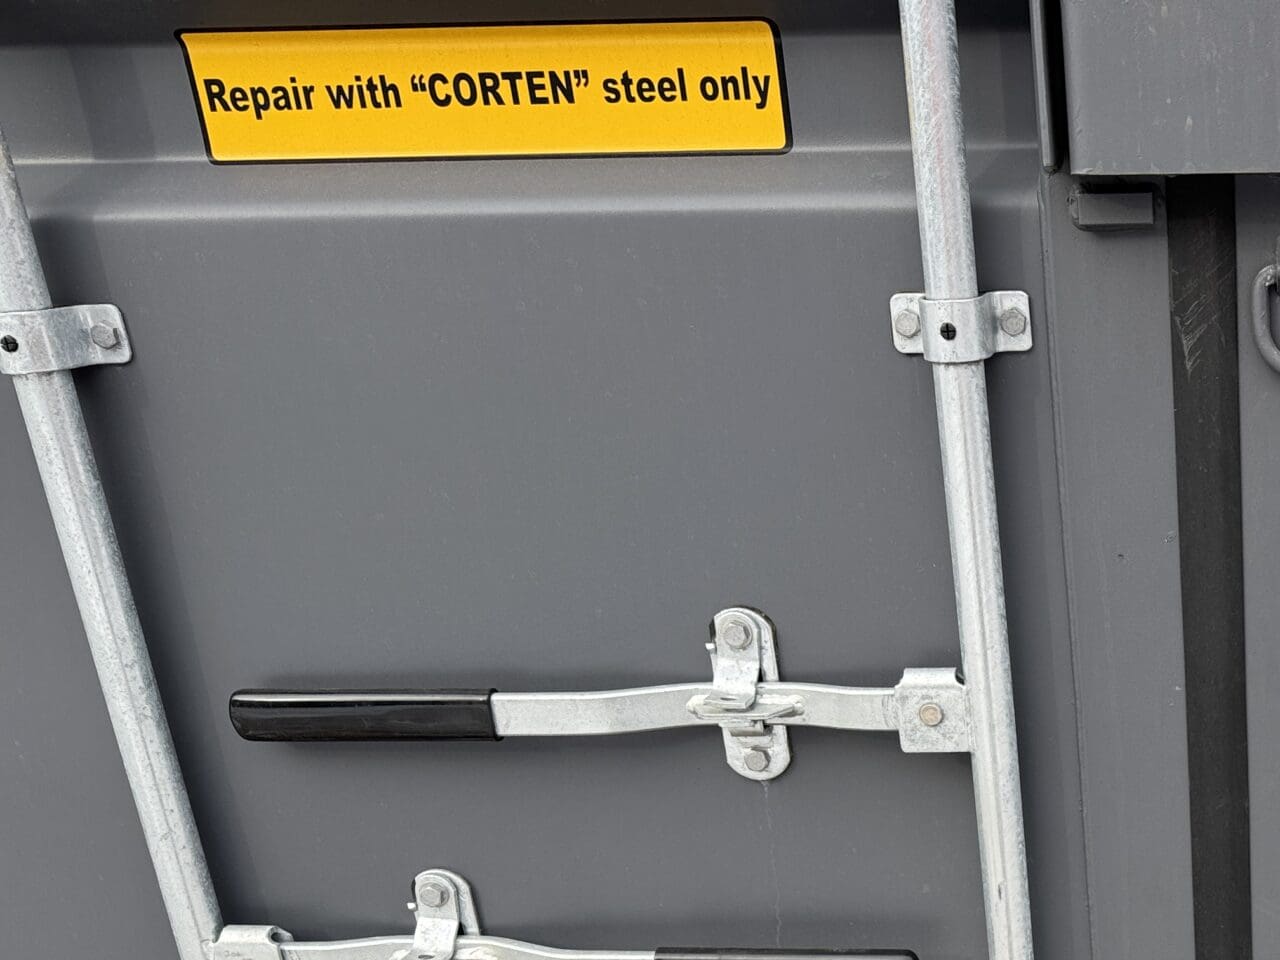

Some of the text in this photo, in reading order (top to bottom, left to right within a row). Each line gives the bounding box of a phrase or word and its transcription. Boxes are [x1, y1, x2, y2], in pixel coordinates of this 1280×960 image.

[203, 76, 314, 120] Repair
[326, 74, 402, 111] with
[603, 68, 688, 104] steel
[699, 66, 771, 110] only
